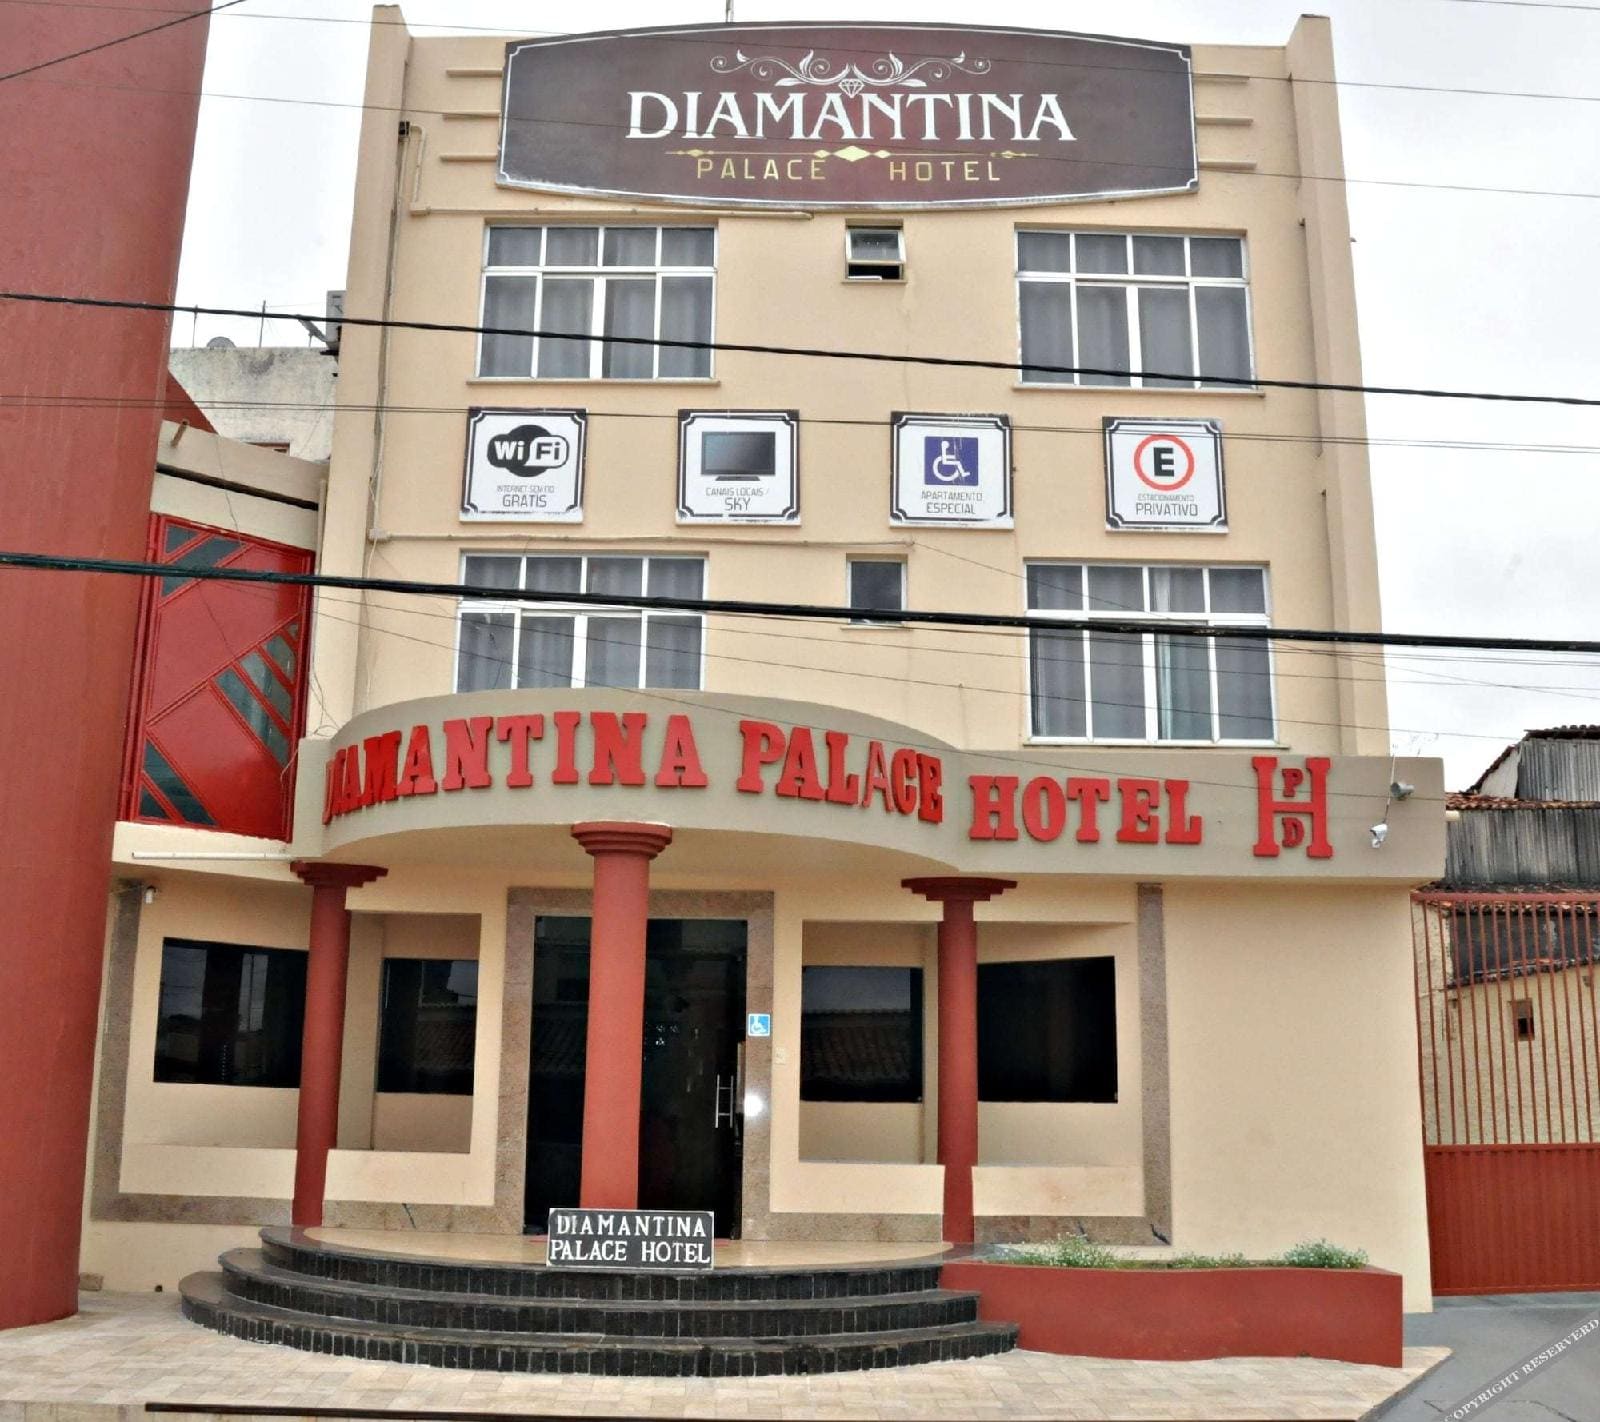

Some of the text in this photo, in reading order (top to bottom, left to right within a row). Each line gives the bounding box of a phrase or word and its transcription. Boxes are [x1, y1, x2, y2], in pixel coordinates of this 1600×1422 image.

[625, 90, 1077, 142] DIAMANTINA
[696, 158, 1001, 183] PALACE HOTEL
[493, 437, 563, 462] WiFi
[1153, 447, 1175, 477] E
[502, 494, 547, 508] GRATIS
[705, 487, 735, 496] CANAIS
[737, 487, 764, 496] LOCAIS
[921, 491, 983, 501] APARTAMENTO
[724, 497, 751, 511] SKY
[926, 502, 976, 514] ESPECIAL
[1135, 502, 1198, 516] PRIVATIVO
[322, 711, 1203, 843] IAMANTINA PALACE HOTEL
[557, 1214, 706, 1237] DIAMANTINA
[550, 1240, 710, 1264] PALACE HOTEL
